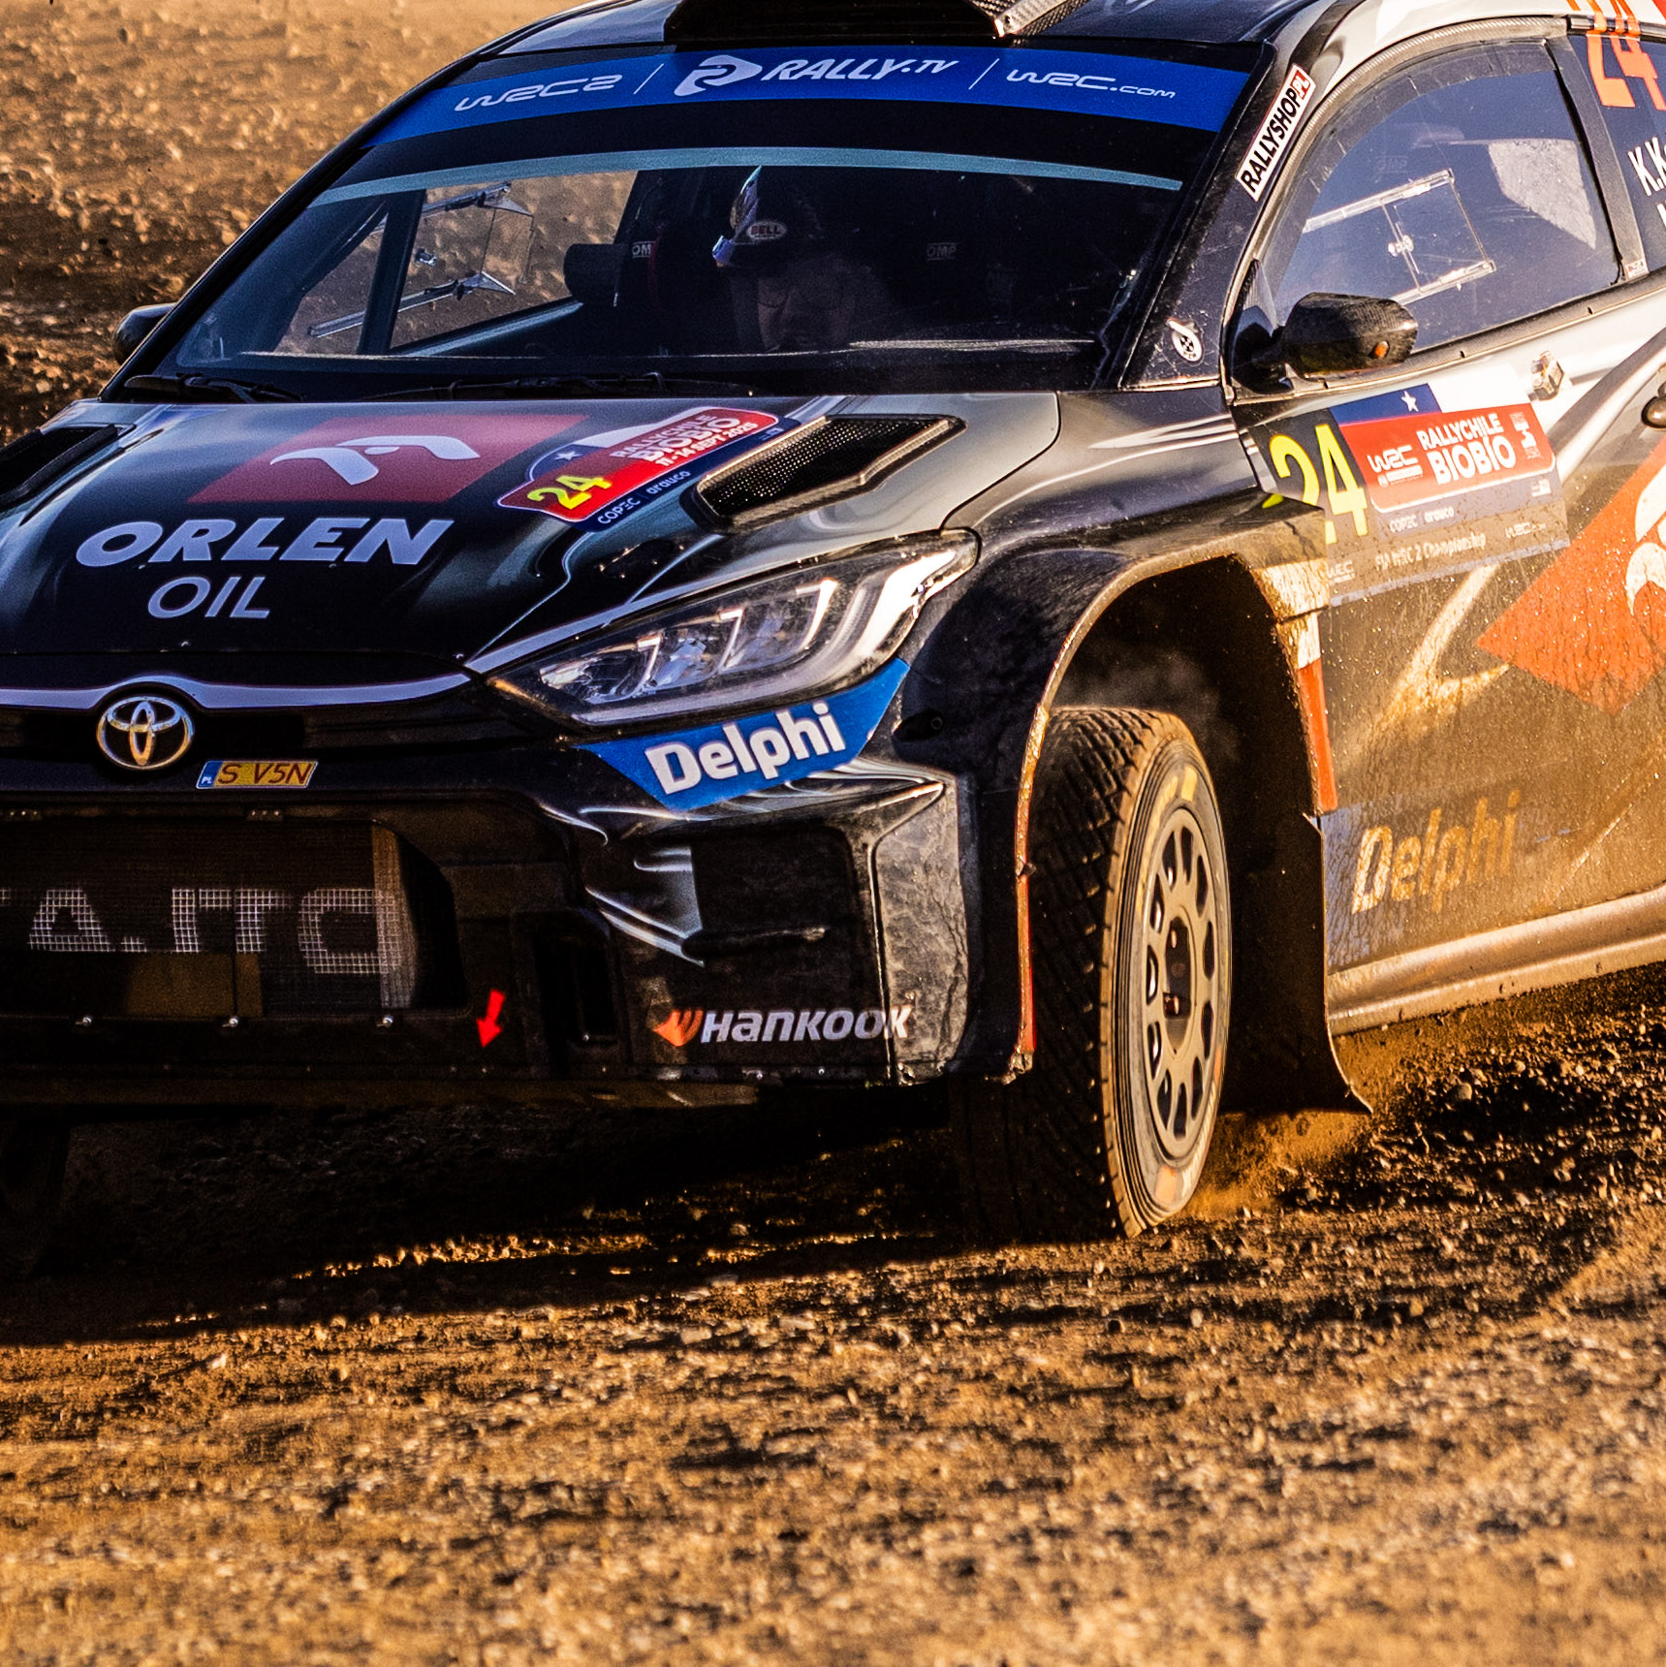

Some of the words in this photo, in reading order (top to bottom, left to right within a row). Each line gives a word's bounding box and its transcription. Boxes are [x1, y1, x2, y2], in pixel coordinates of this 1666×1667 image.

[1416, 413, 1504, 450] RALLYCHILE
[1366, 444, 1419, 473] WRC
[527, 474, 613, 510] 24
[645, 470, 691, 495] arauco
[1262, 422, 1369, 548] 24
[76, 517, 454, 567] ORLEN
[146, 575, 271, 620] OIL
[645, 700, 847, 795] Delphi
[218, 763, 242, 784] S
[253, 763, 313, 784] V5N
[1352, 789, 1521, 915] Delphi
